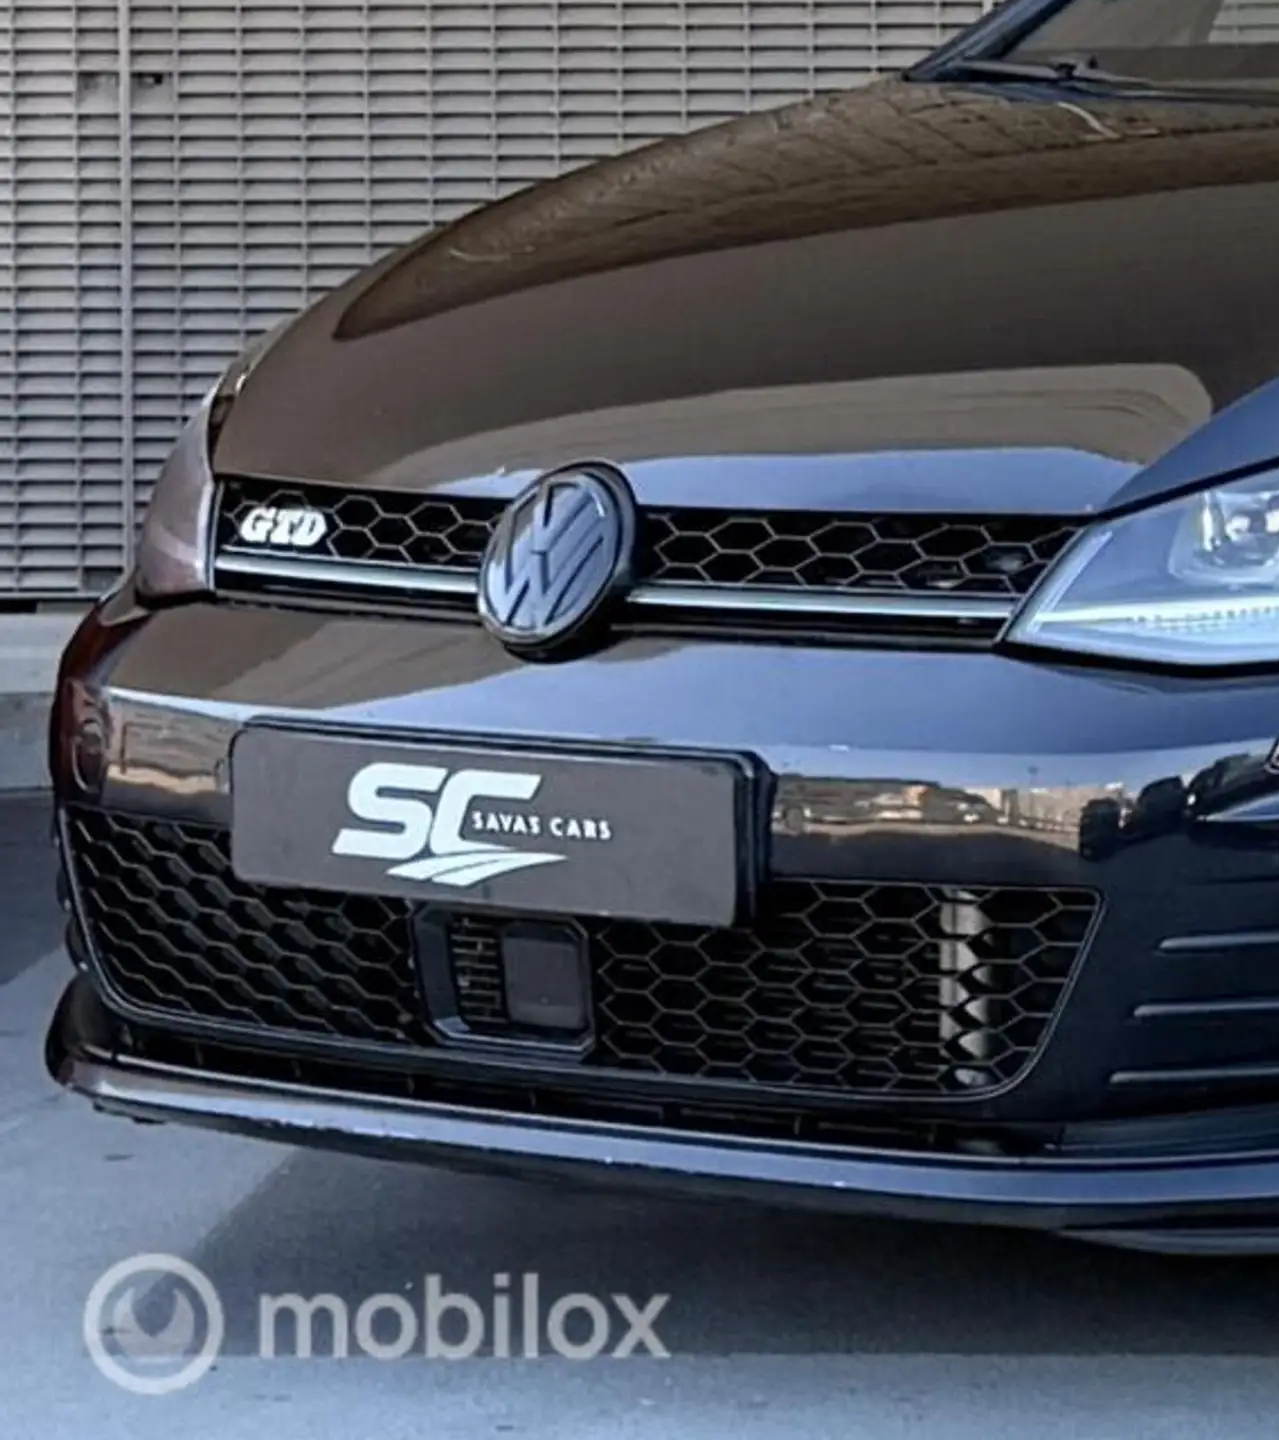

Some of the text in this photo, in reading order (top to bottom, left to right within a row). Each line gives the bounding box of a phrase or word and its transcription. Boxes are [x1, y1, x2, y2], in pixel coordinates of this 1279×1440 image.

[239, 506, 328, 547] GTD
[332, 762, 542, 859] SC
[471, 811, 611, 841] SAVAS CARS
